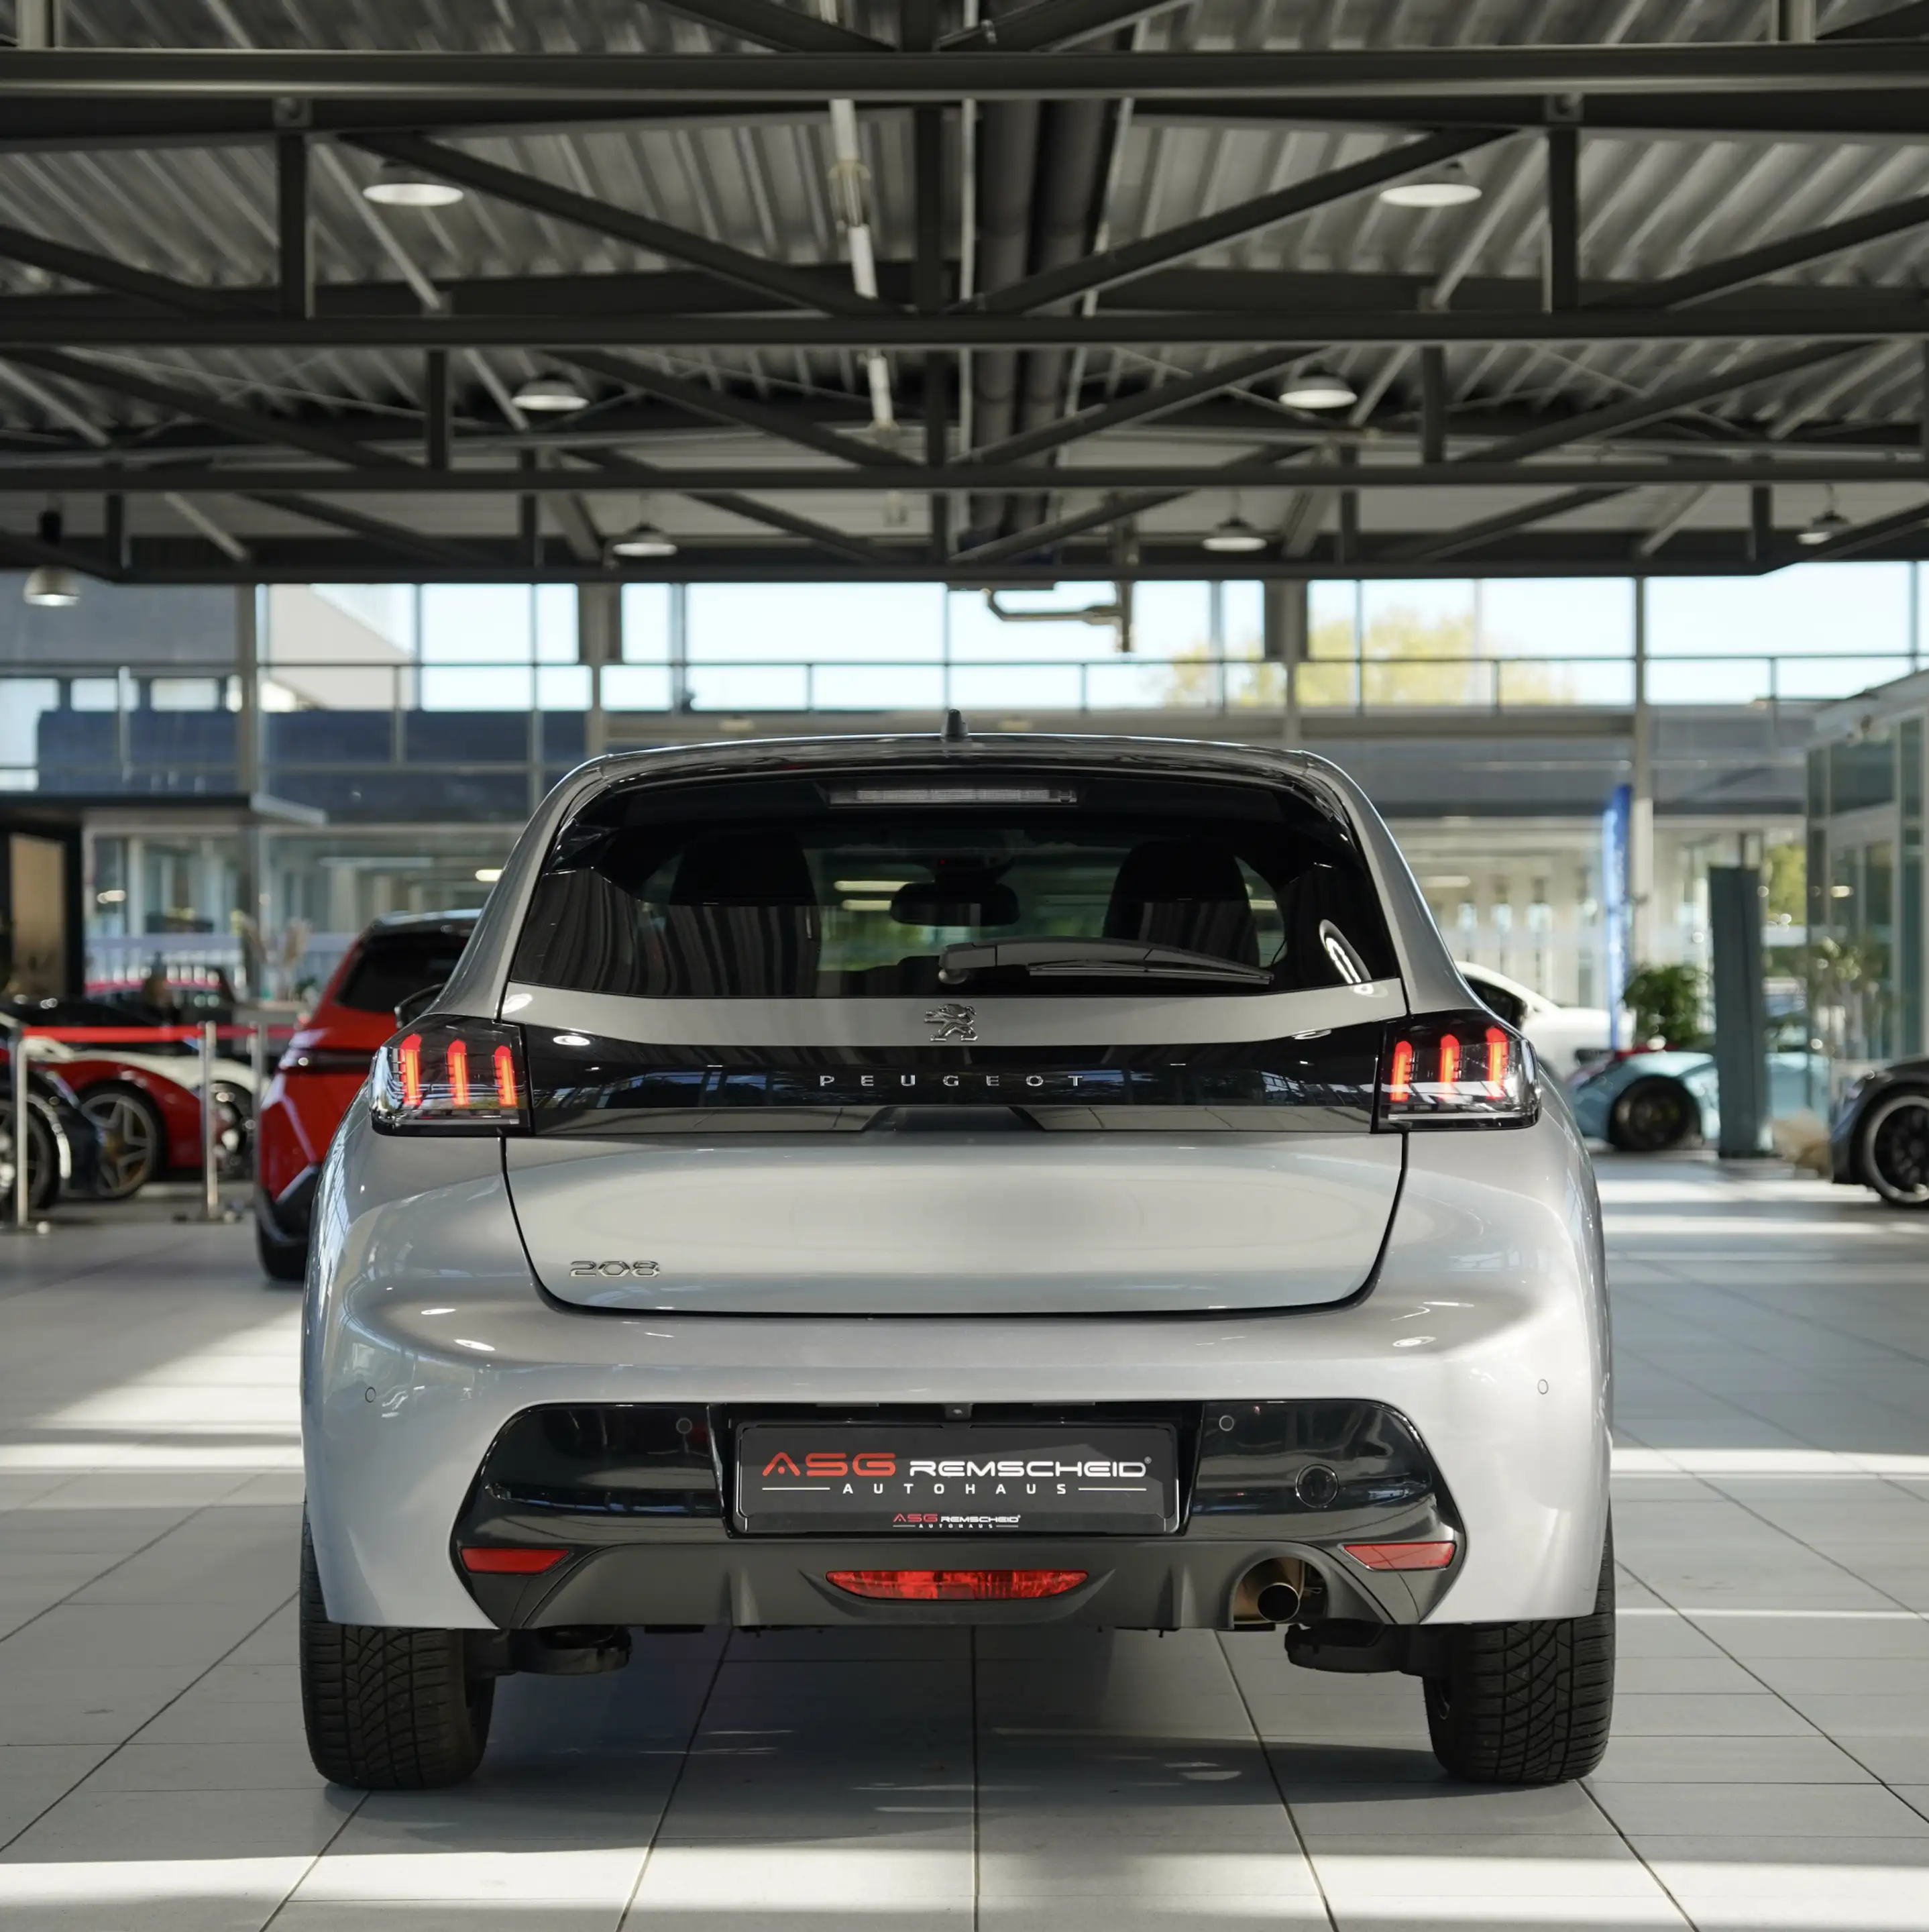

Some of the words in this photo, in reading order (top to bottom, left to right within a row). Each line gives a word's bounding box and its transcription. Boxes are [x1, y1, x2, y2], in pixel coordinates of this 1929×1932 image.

[819, 1075, 1084, 1087] PEUGEOT
[569, 1260, 661, 1277] 208
[761, 1452, 896, 1477] ASG
[842, 1483, 1067, 1495] AUTOHAUS
[893, 1513, 938, 1523] ASG
